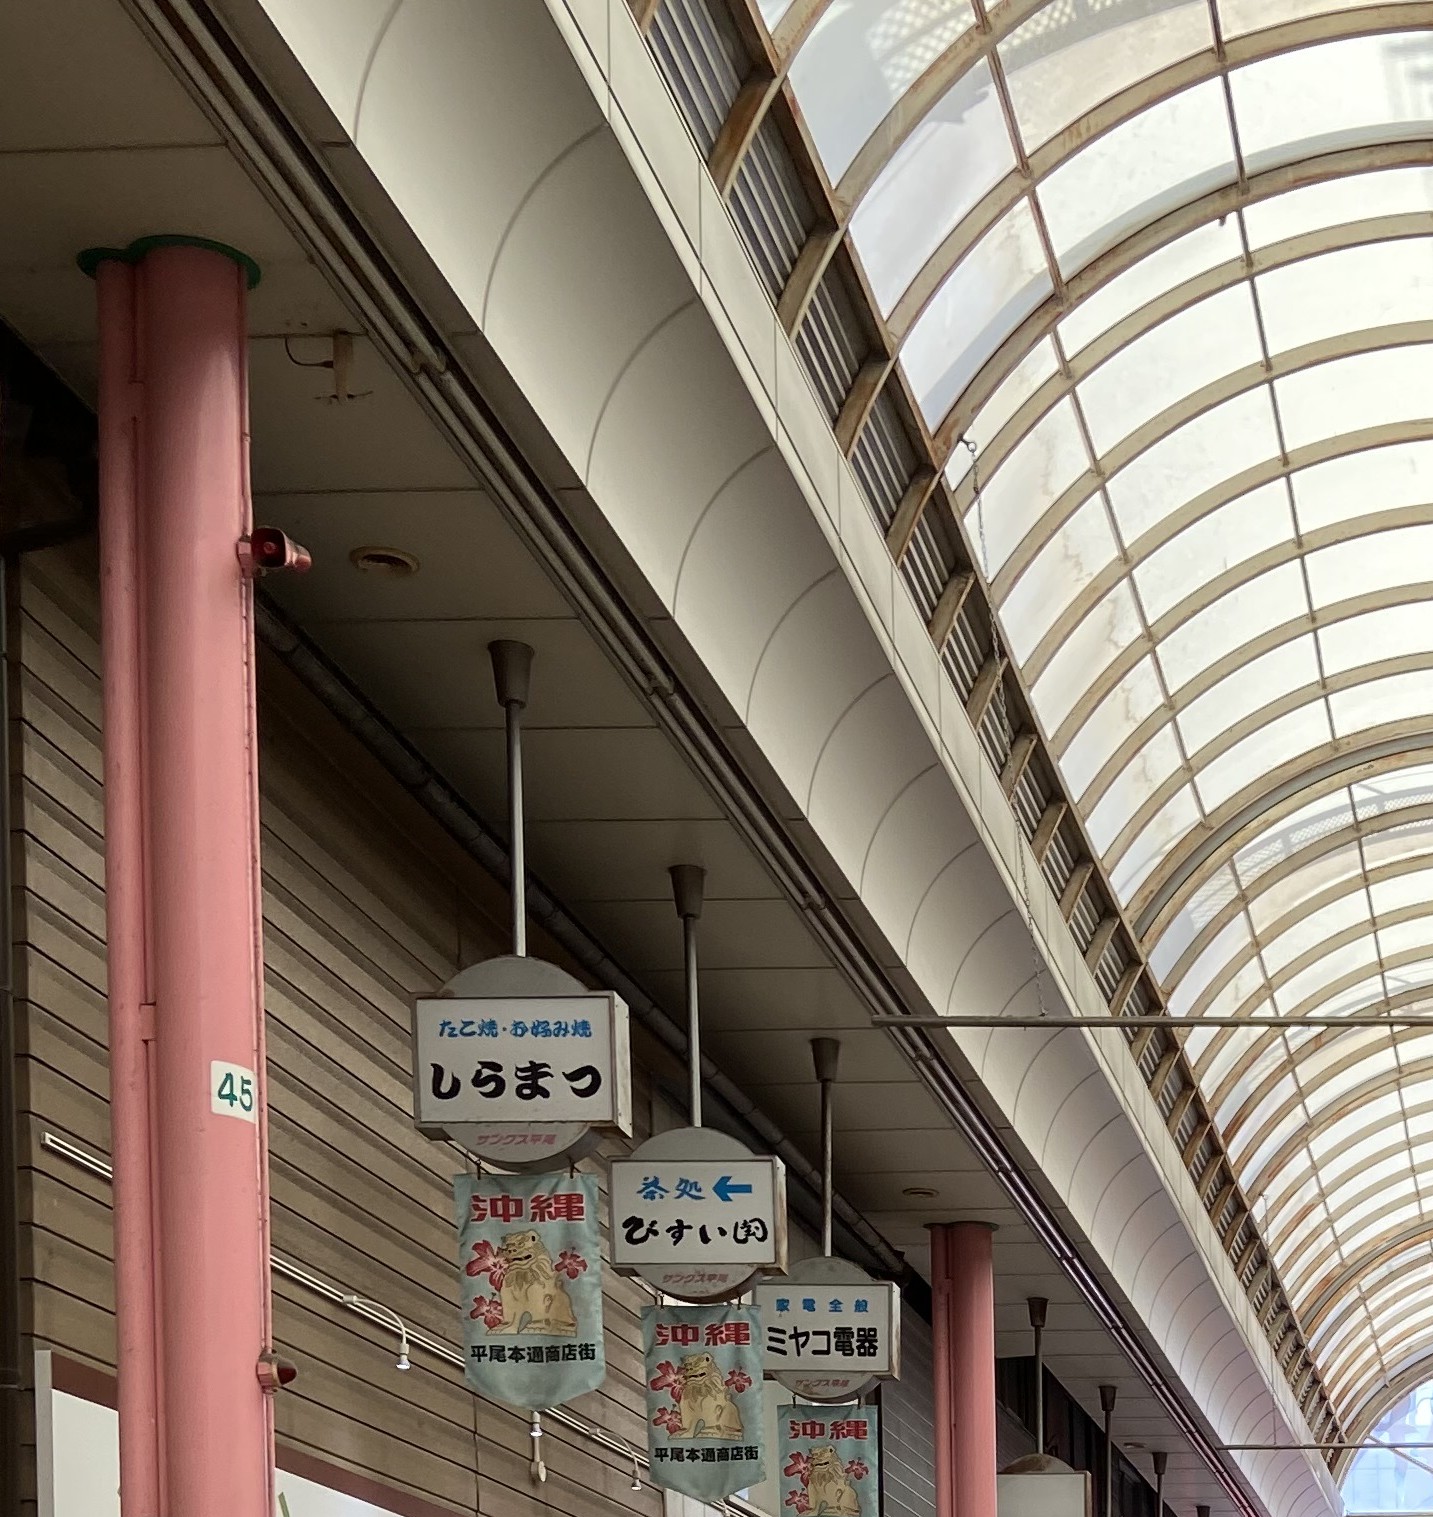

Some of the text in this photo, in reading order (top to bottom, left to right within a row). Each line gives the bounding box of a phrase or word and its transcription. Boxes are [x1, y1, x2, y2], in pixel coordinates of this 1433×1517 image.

[438, 1018, 592, 1038] たこ焼・お好み焼
[217, 1071, 253, 1112] 45
[430, 1060, 602, 1100] しらまつ
[637, 1176, 706, 1201] 茶処
[470, 1192, 586, 1223] 沖縄
[776, 1298, 868, 1313] 家電全般
[655, 1322, 751, 1347] 沖縄
[766, 1326, 878, 1357] ミヤコ電器
[470, 1343, 596, 1363] 平尾本通商店街
[788, 1420, 868, 1440] 沖縄
[654, 1446, 759, 1463] 平尾本通商店街
